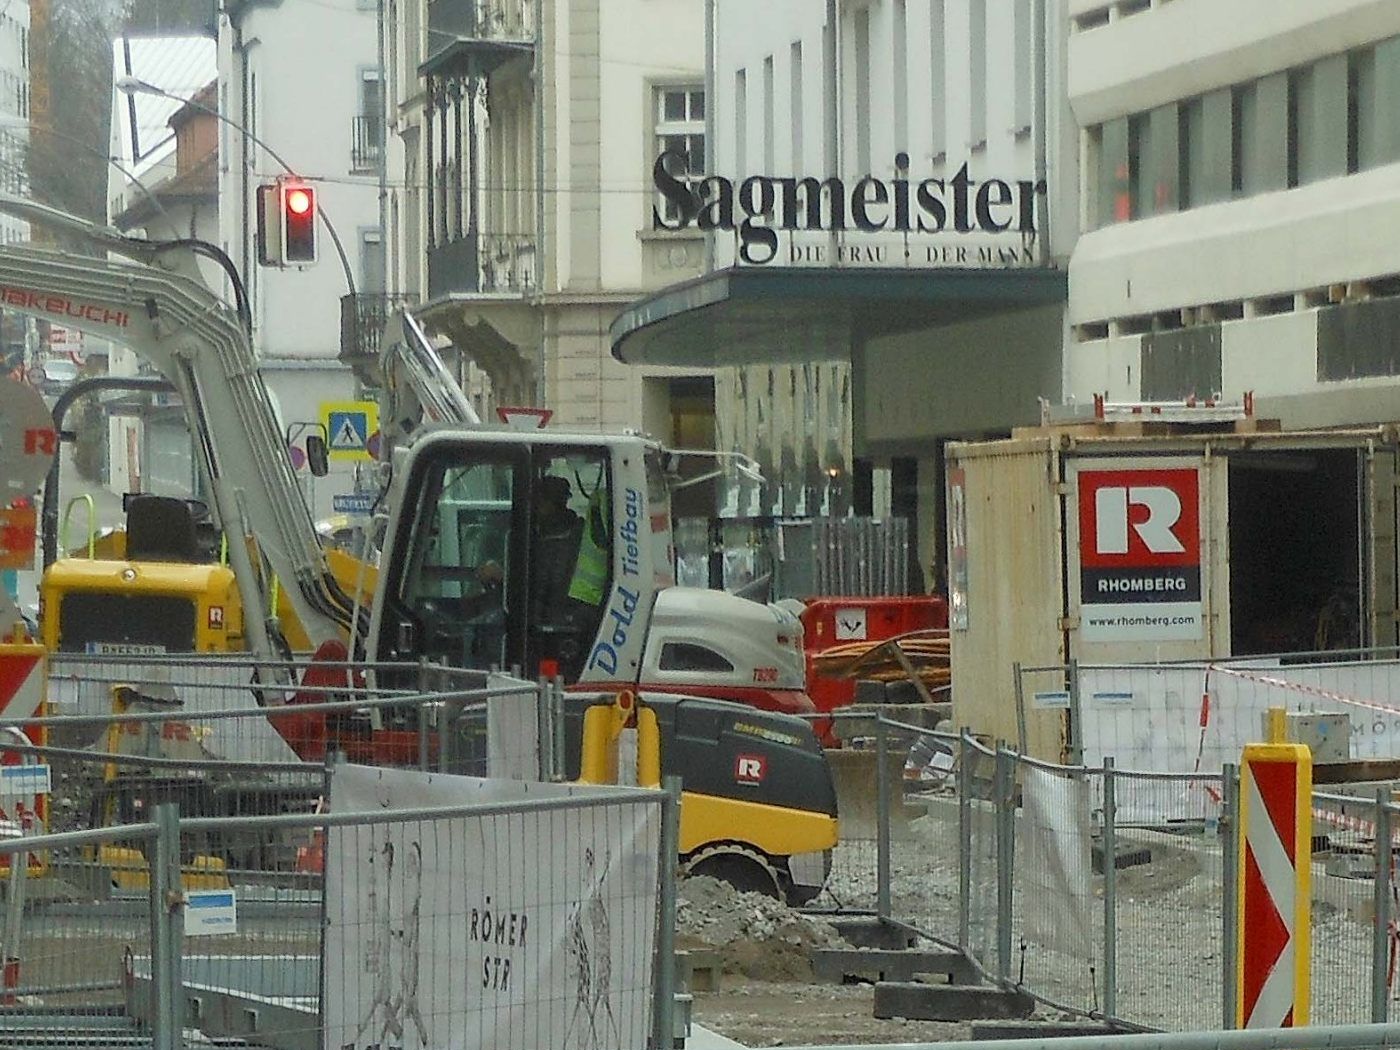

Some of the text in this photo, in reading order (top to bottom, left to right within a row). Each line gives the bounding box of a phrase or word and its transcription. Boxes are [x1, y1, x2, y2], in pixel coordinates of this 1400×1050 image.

[652, 151, 1047, 265] Sagmeister
[789, 246, 1036, 263] DIE FRAU DER MANN
[1095, 486, 1186, 554] R
[588, 487, 641, 677] Dold Tiefbau
[1098, 578, 1186, 592] RHOMBERG
[1089, 615, 1195, 628] www.rhomberg.com
[738, 758, 762, 778] R
[470, 895, 529, 948] RÖMER
[483, 955, 512, 991] STR
